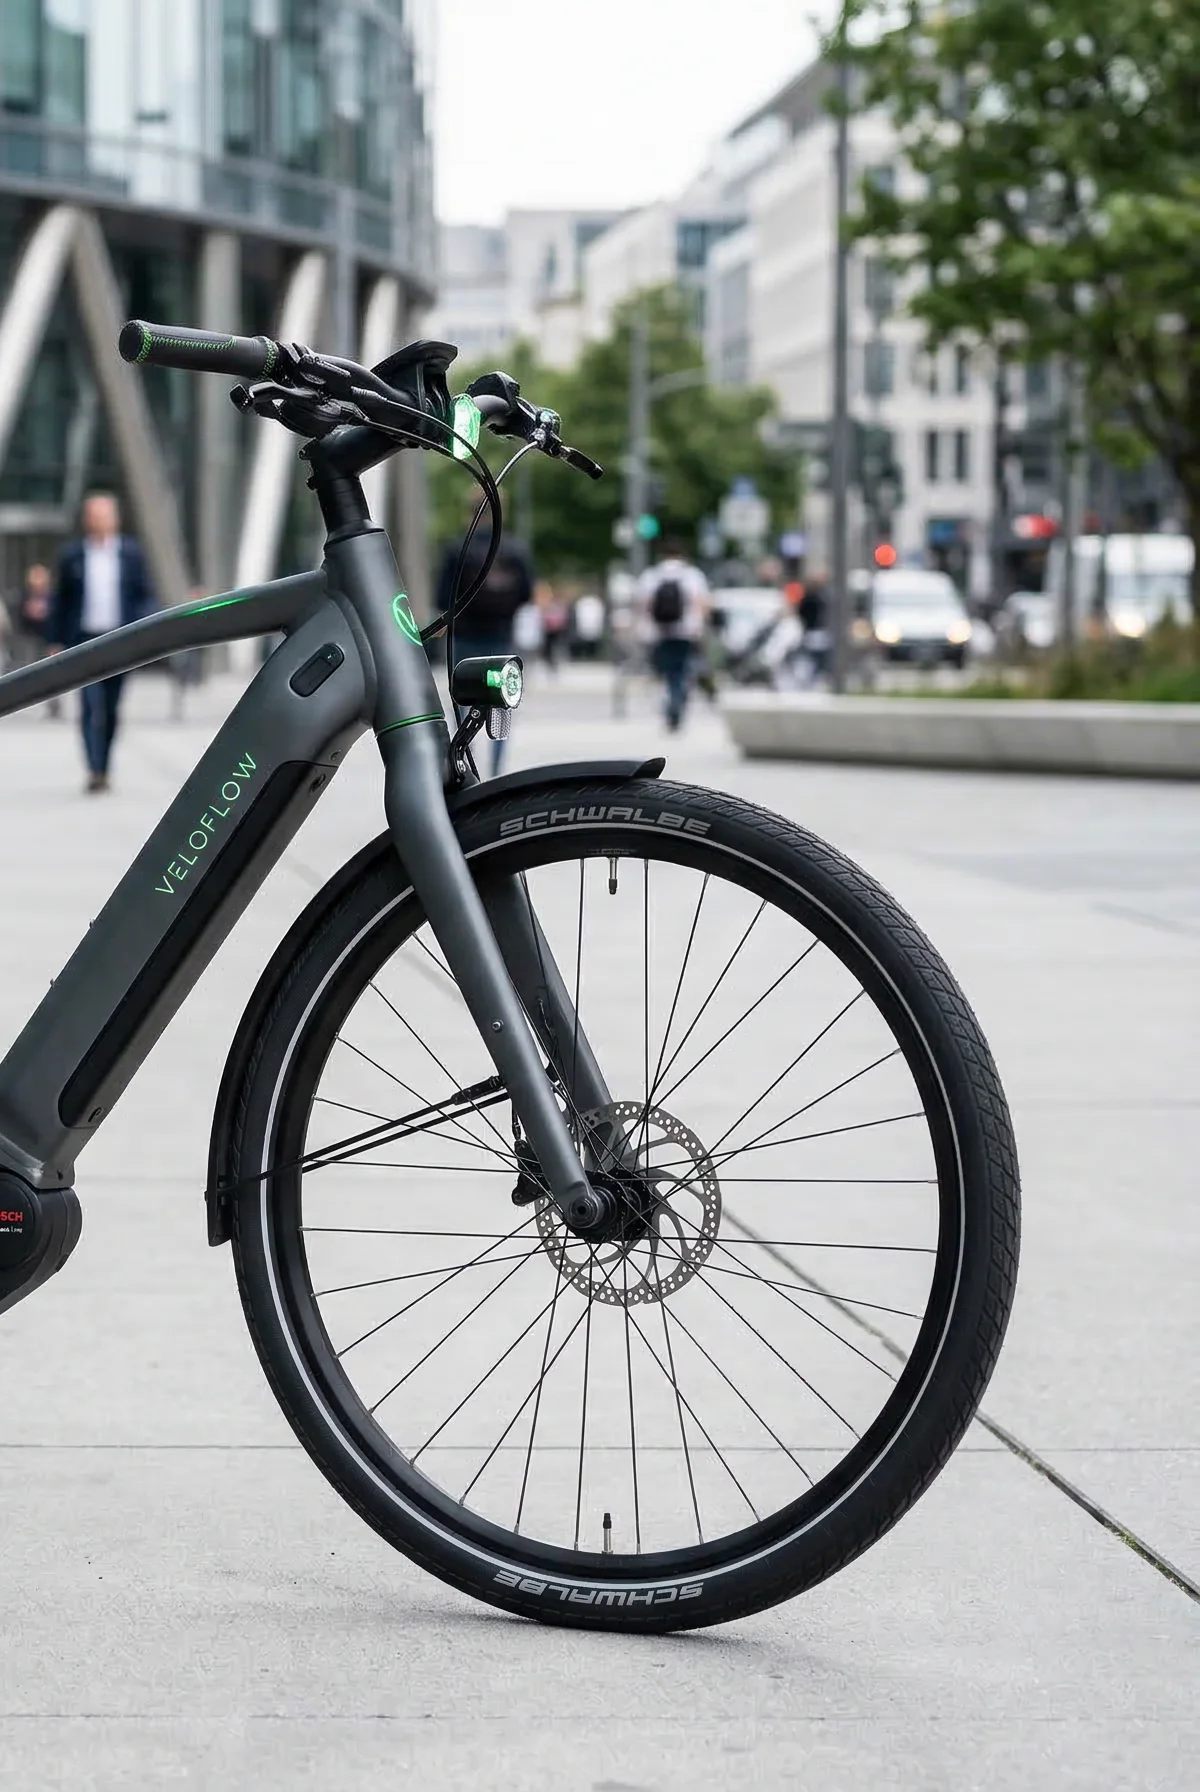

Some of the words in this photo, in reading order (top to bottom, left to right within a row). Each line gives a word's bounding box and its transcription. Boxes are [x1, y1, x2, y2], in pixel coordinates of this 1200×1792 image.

[155, 752, 257, 894] VELOFLOW
[500, 806, 711, 837] SCHWALBE
[493, 1569, 704, 1606] SCHWALBE
